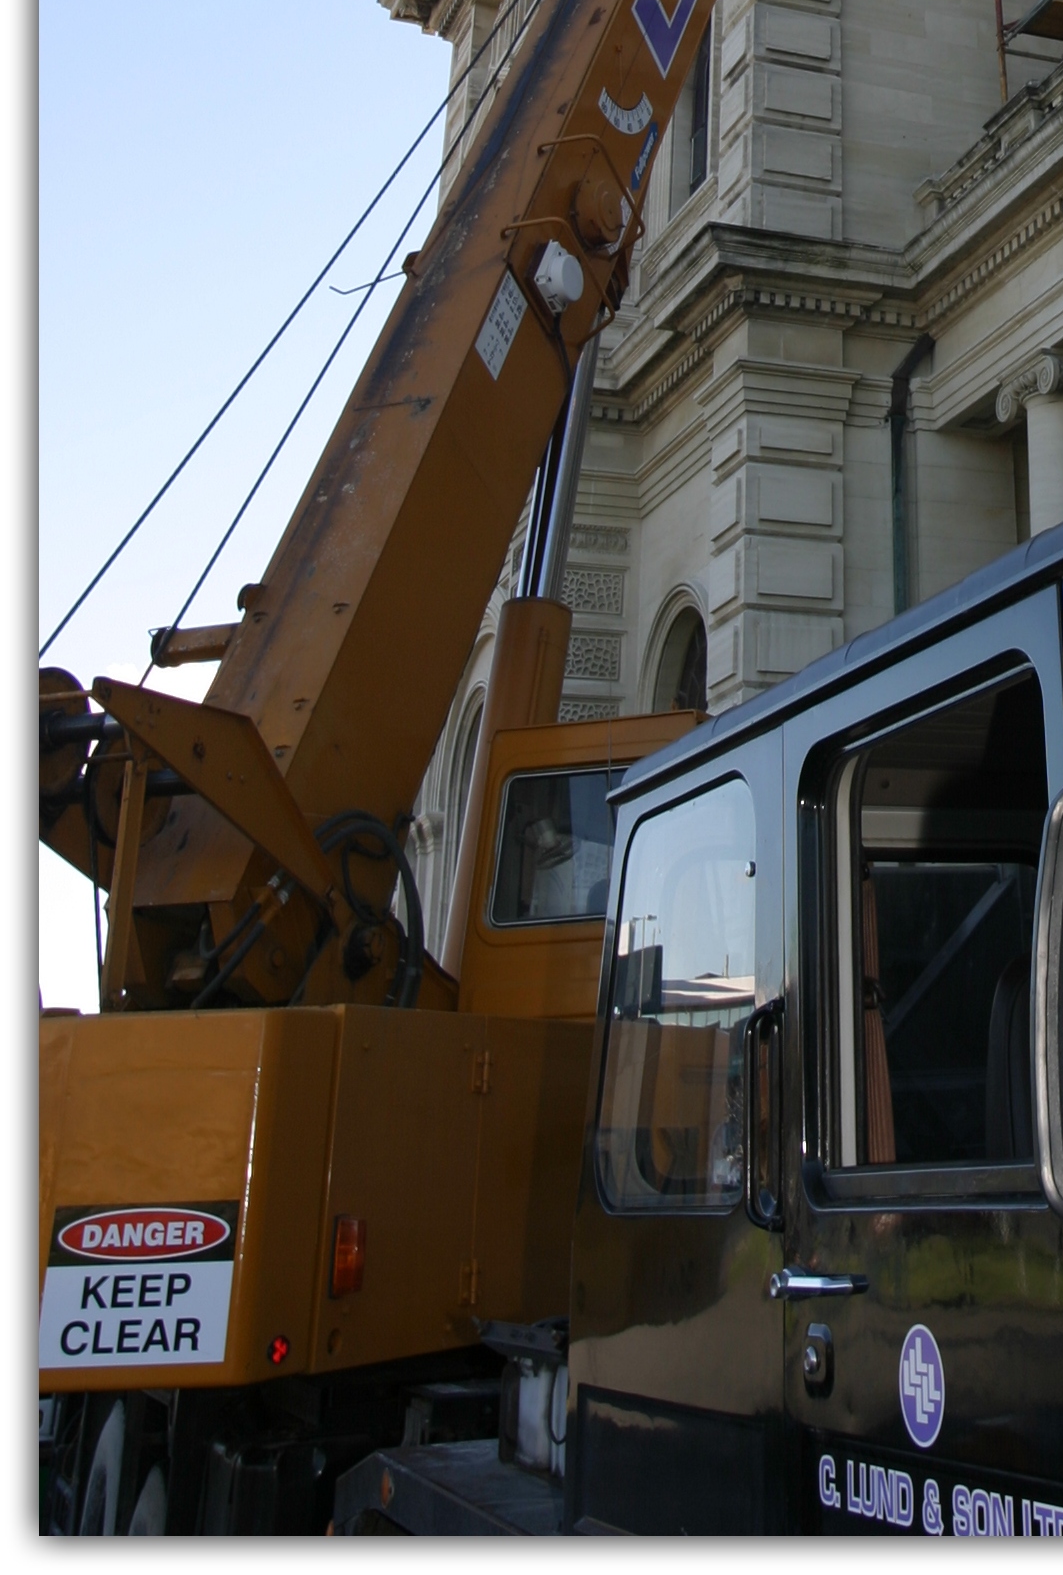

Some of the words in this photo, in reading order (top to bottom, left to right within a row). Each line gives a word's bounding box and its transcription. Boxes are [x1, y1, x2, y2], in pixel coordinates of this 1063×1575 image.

[81, 1220, 205, 1249] DANGER
[80, 1273, 192, 1310] KEEP
[60, 1317, 202, 1356] CLEAR
[819, 1454, 841, 1509] C.
[846, 1459, 914, 1528] LUND
[921, 1478, 945, 1536] &
[952, 1484, 1015, 1536] SON
